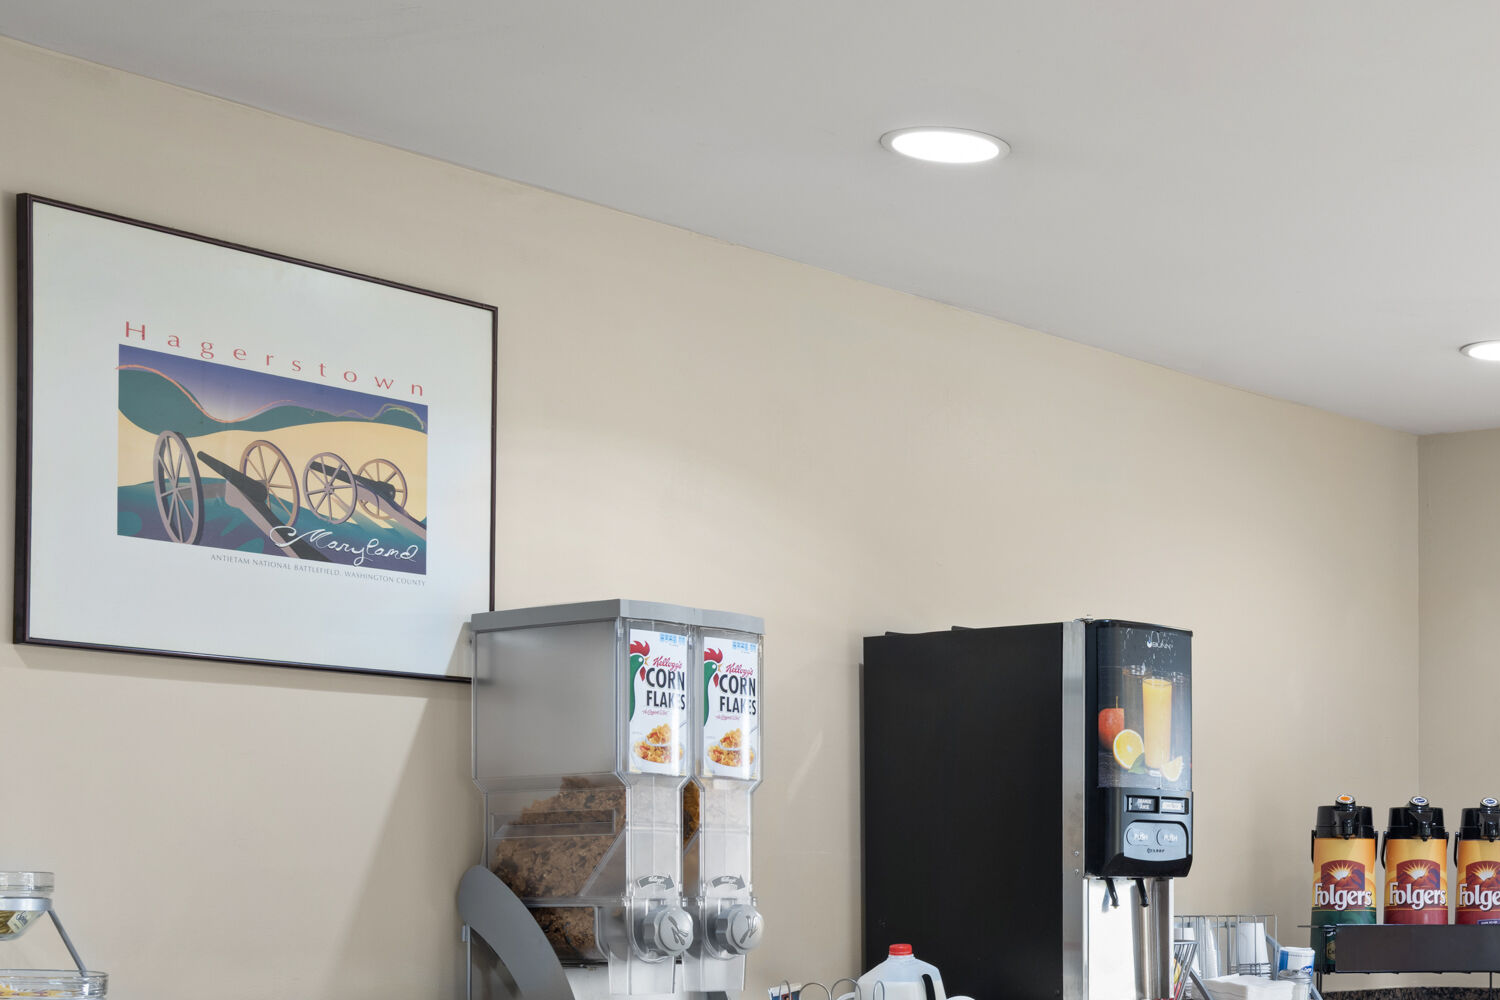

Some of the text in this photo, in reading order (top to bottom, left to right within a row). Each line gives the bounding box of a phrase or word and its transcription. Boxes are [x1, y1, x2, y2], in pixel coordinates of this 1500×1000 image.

[126, 321, 423, 396] Hagerstown
[269, 525, 418, 567] Maryland
[211, 554, 250, 565] ANTIETAM
[252, 559, 291, 571] NATIONAL
[344, 570, 394, 583] WASHINGTON
[396, 577, 426, 587] COUNTY
[652, 656, 682, 672] Kellogg's
[725, 663, 754, 678] Kellogg's
[645, 668, 685, 691] CORN
[719, 674, 756, 697] CORN
[646, 690, 685, 711] FLAKS
[1313, 882, 1373, 911] Folgers
[1388, 881, 1447, 910] Folgers
